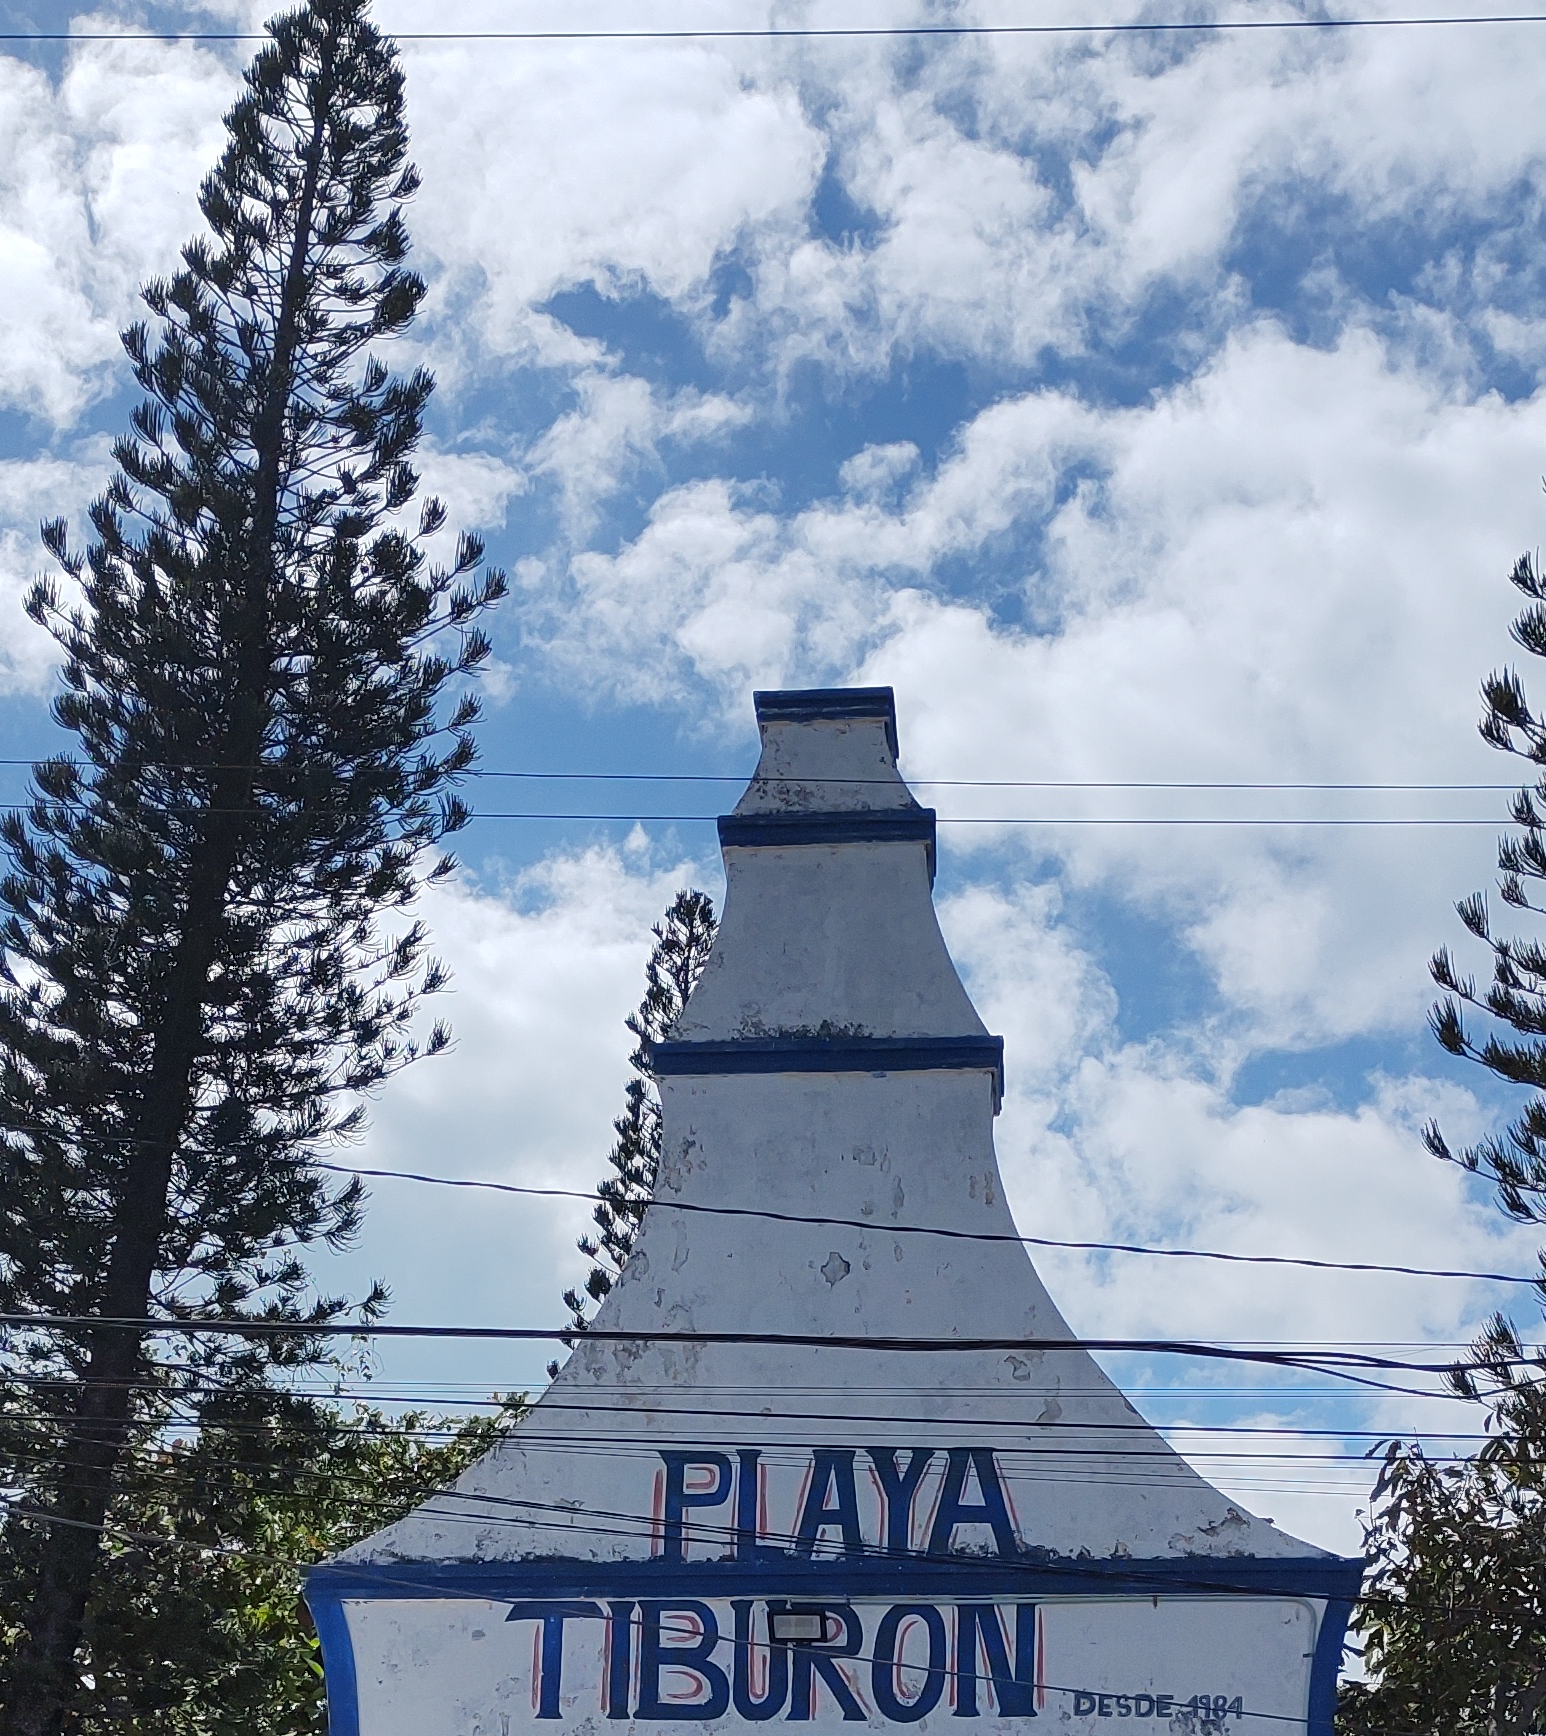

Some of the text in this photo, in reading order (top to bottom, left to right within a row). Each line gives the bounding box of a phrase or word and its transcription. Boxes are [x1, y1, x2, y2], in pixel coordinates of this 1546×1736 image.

[655, 1447, 1020, 1562] PLAYA
[506, 1600, 1045, 1722] TIBURON
[1072, 1692, 1175, 1718] DESDE
